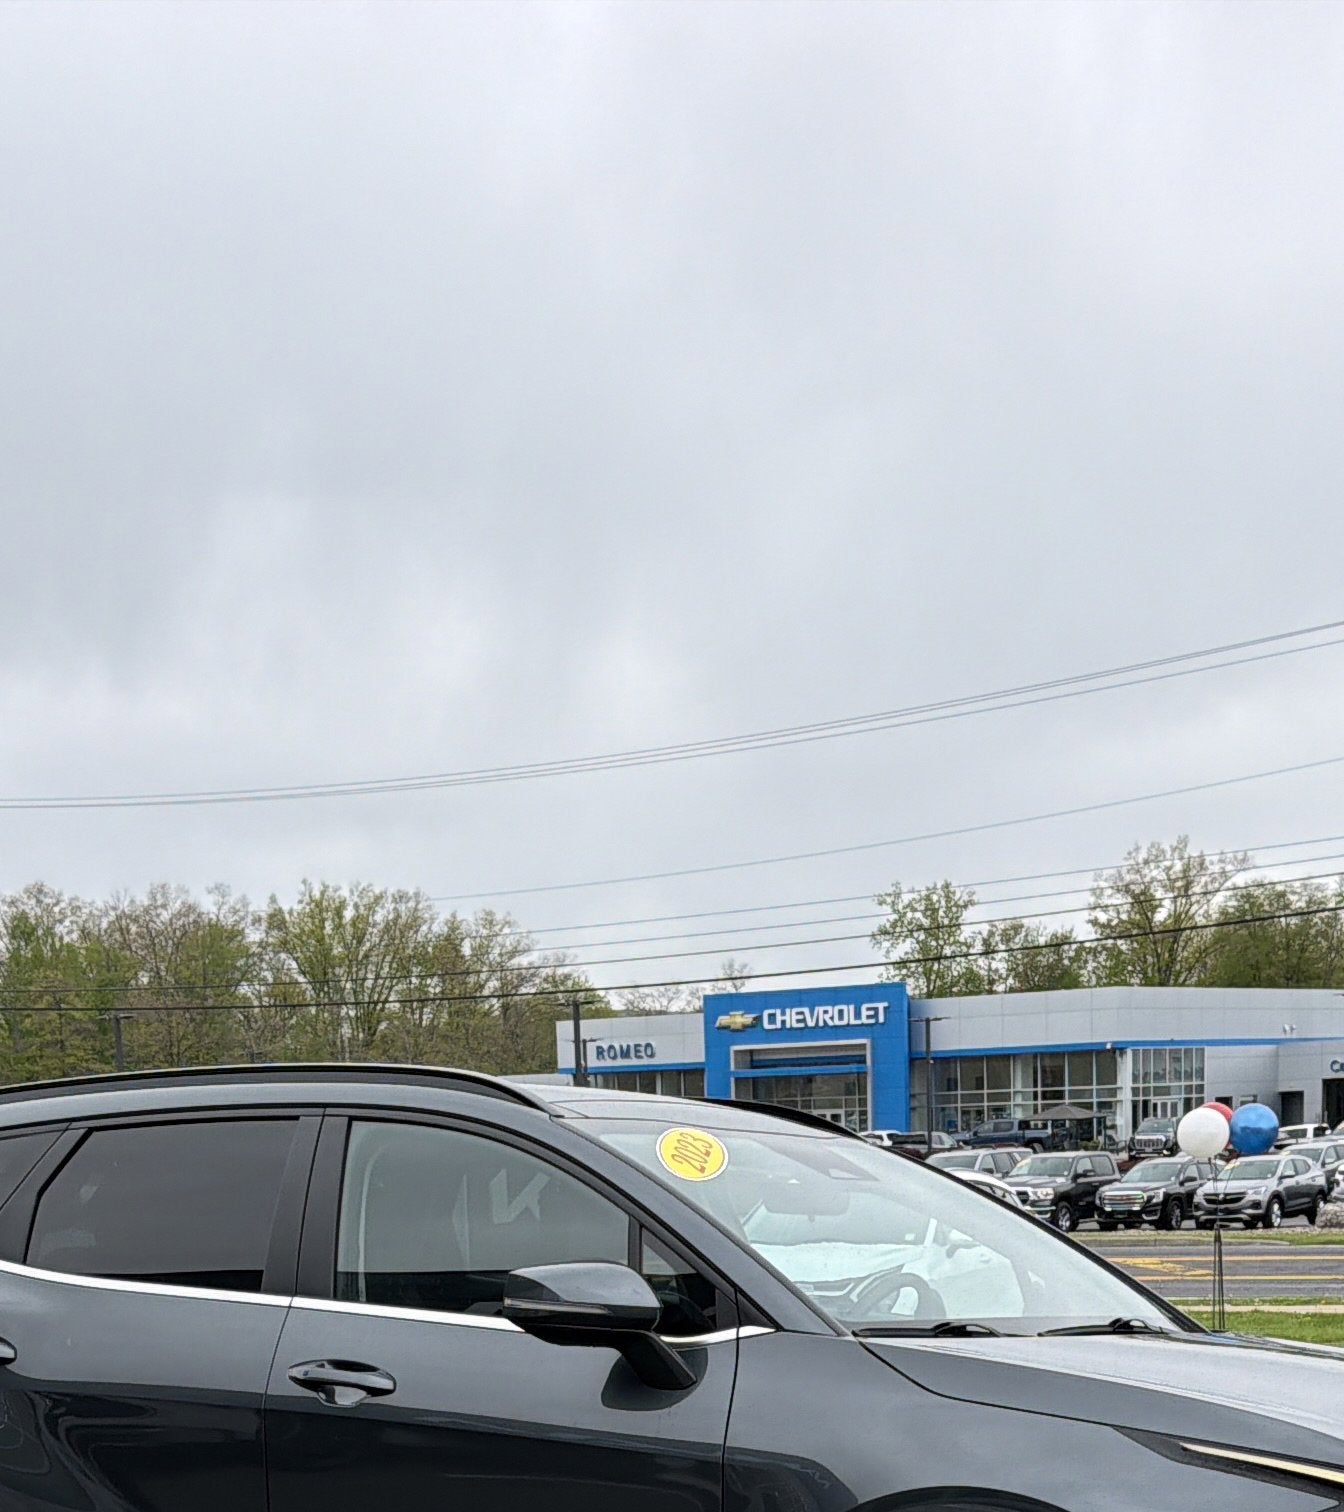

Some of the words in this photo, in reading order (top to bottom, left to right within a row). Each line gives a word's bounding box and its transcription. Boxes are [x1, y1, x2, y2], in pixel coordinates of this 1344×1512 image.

[762, 1001, 889, 1030] CHEVROLET
[595, 1042, 656, 1061] ROMEO
[671, 1132, 713, 1174] 2023
